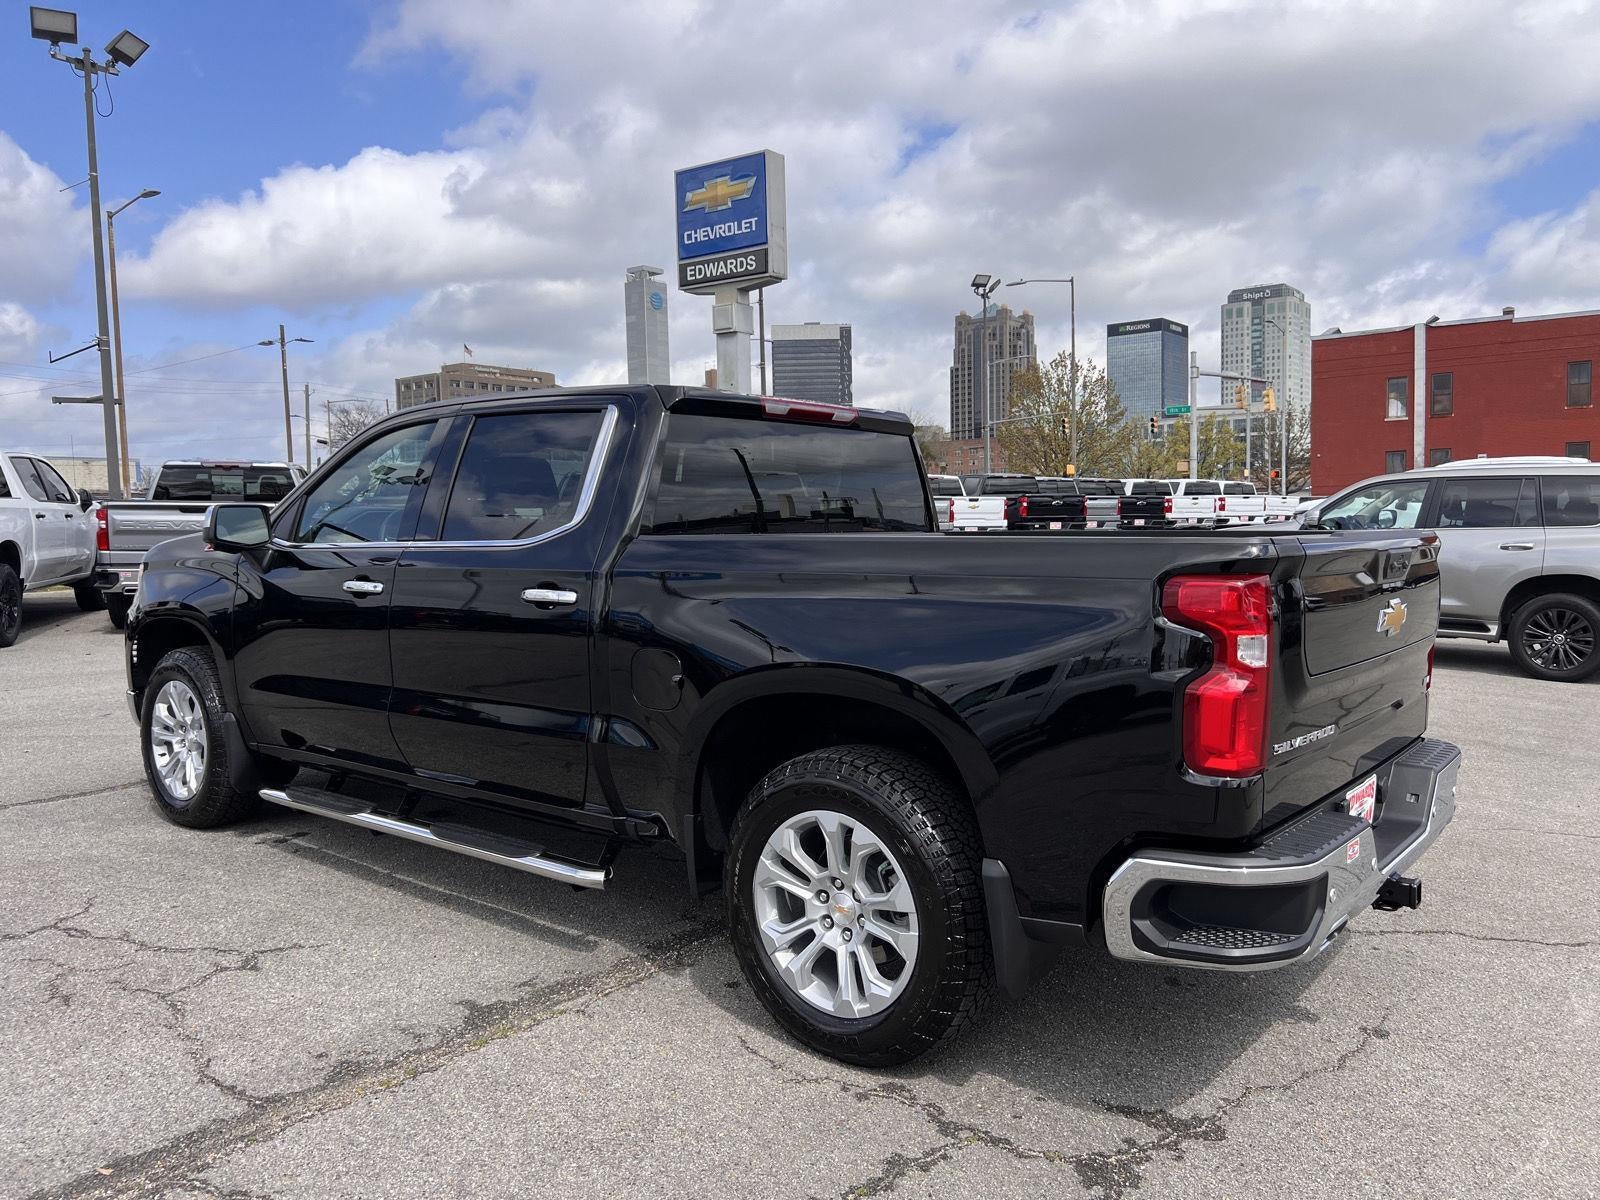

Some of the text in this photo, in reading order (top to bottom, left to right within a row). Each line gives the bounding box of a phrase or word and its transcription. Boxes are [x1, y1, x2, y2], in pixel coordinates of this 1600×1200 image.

[684, 218, 758, 244] CHEVROLET
[687, 256, 756, 280] EDWARDS
[119, 520, 202, 530] CHEVR
[1273, 724, 1335, 755] SILVERADO
